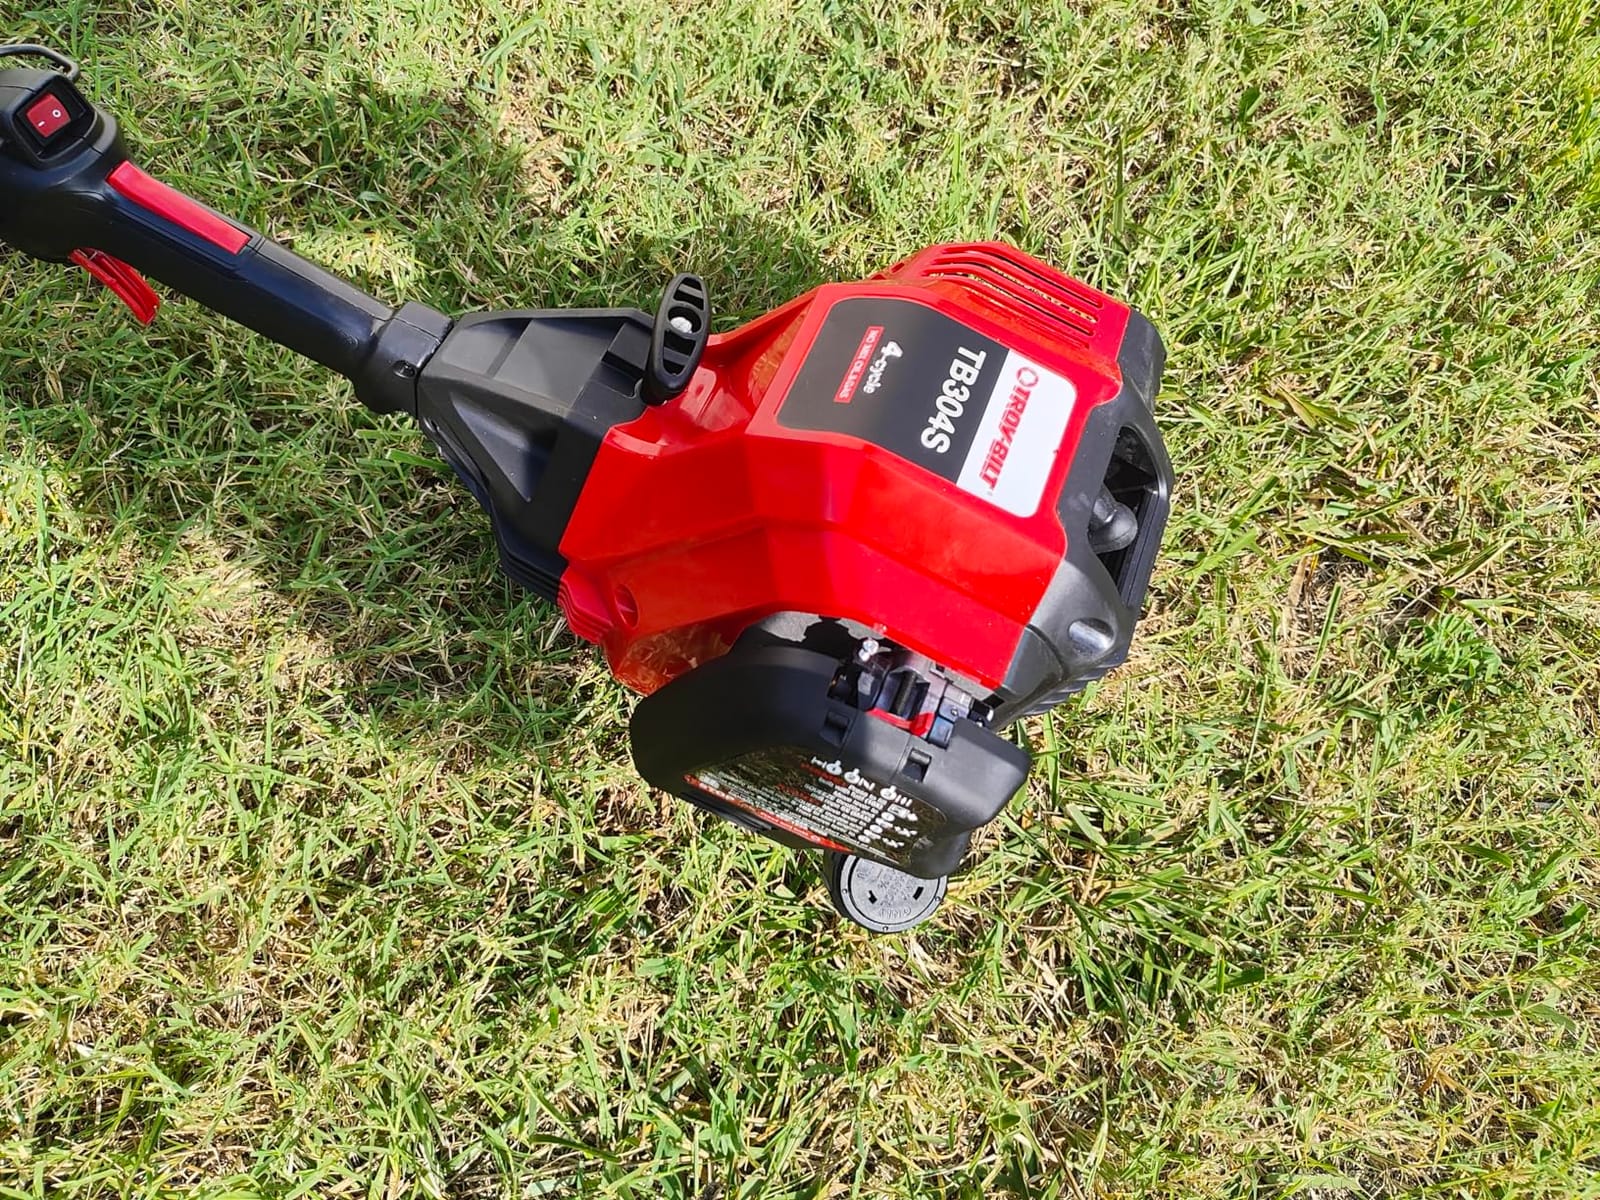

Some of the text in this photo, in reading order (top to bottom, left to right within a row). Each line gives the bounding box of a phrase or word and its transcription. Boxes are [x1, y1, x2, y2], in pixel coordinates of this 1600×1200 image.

[863, 341, 903, 394] 4-cycle
[920, 346, 987, 454] TB304S
[979, 384, 1032, 491] TROY-BILT
